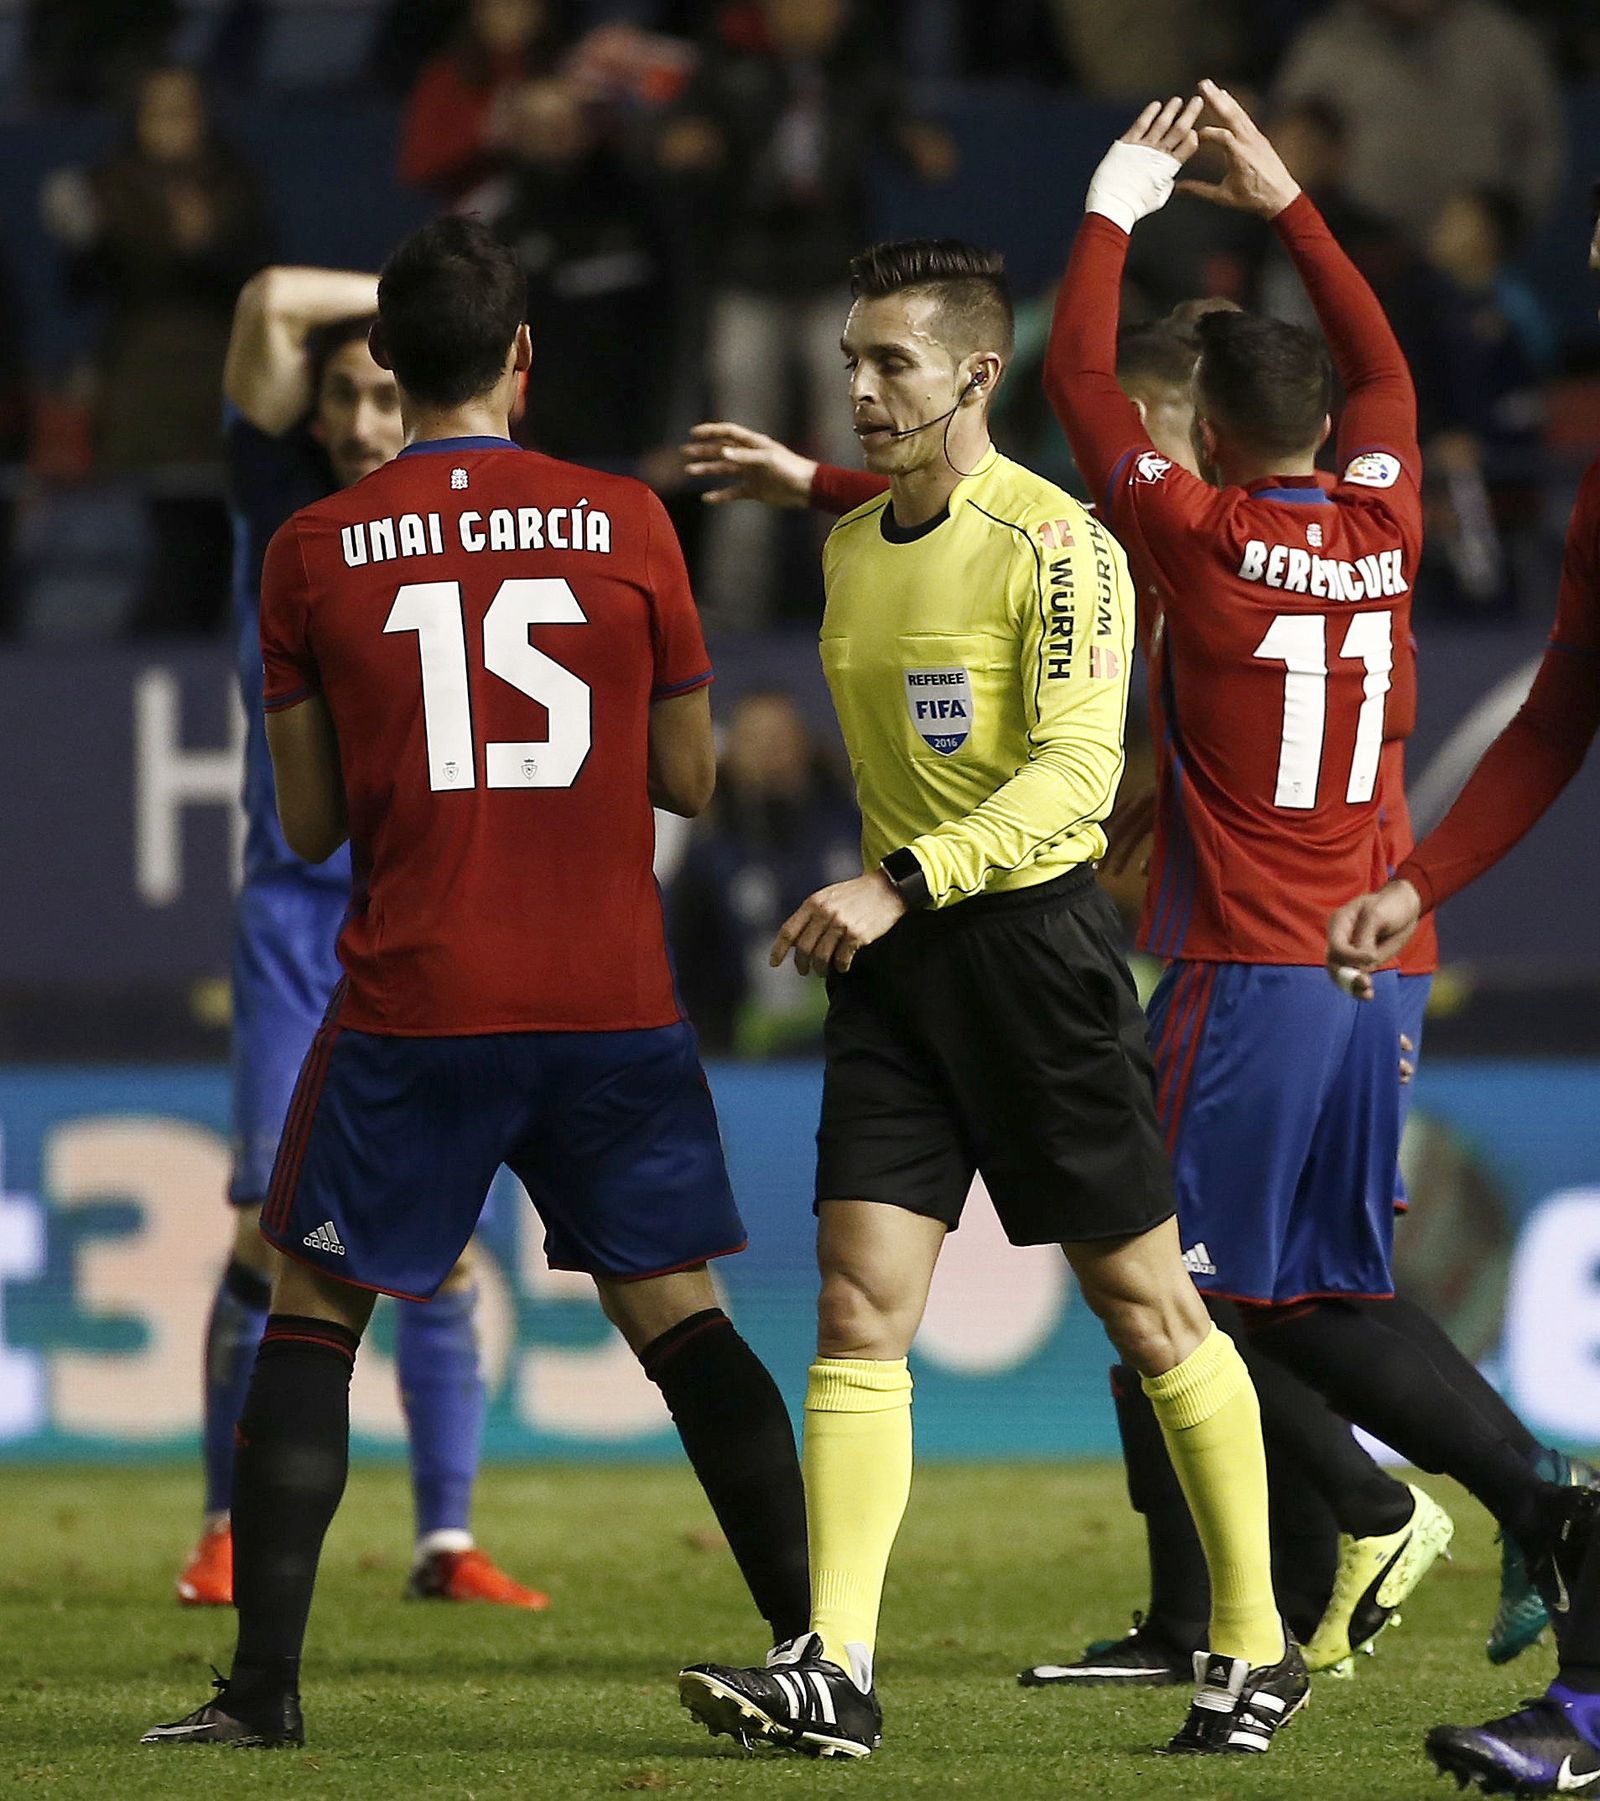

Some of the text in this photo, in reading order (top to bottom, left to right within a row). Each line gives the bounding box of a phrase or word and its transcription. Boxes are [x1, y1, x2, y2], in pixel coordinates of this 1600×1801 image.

[341, 497, 611, 567] UNAI GARCÍA
[1084, 519, 1112, 636] WÜRTH
[1047, 556, 1075, 680] WÜRTH
[382, 576, 592, 791] 15
[907, 672, 965, 687] REFEREE
[915, 699, 967, 720] FIFA
[1252, 610, 1394, 810] 11
[933, 737, 959, 748] 2016
[303, 1236, 346, 1256] adidas
